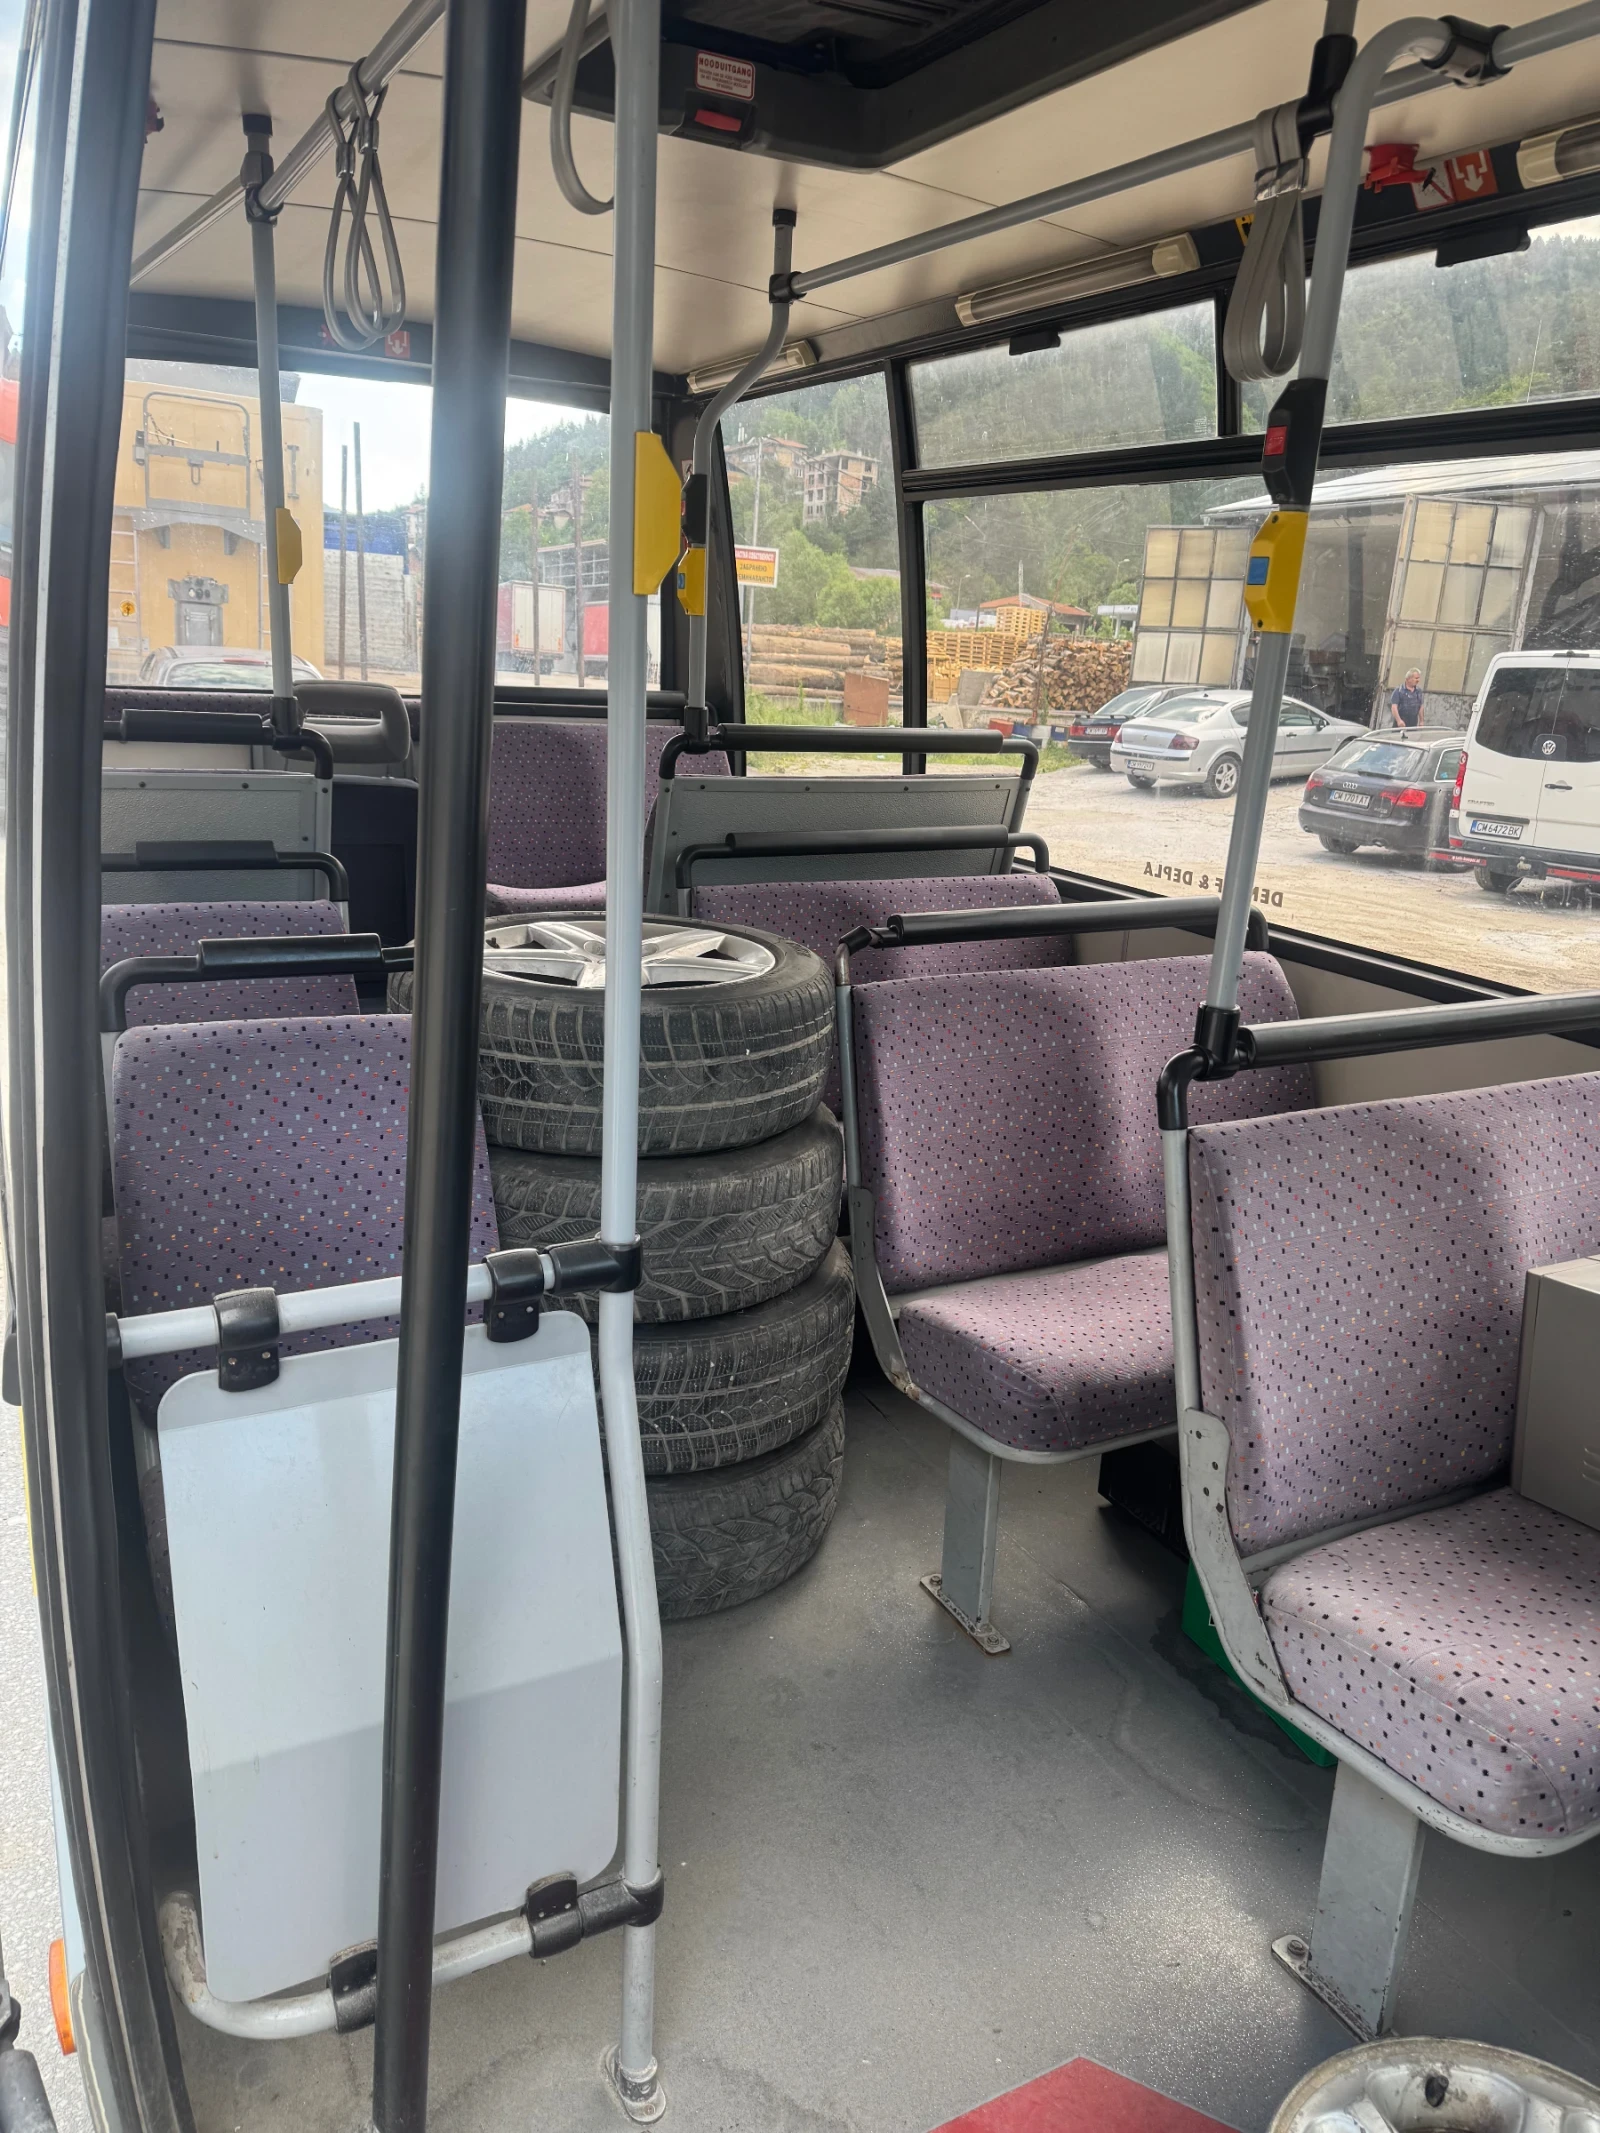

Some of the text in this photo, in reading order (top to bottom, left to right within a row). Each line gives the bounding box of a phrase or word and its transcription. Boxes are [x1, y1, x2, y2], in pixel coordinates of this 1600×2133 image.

[699, 57, 751, 77] NOODUITGANG
[1476, 822, 1520, 836] CM 6472 BK
